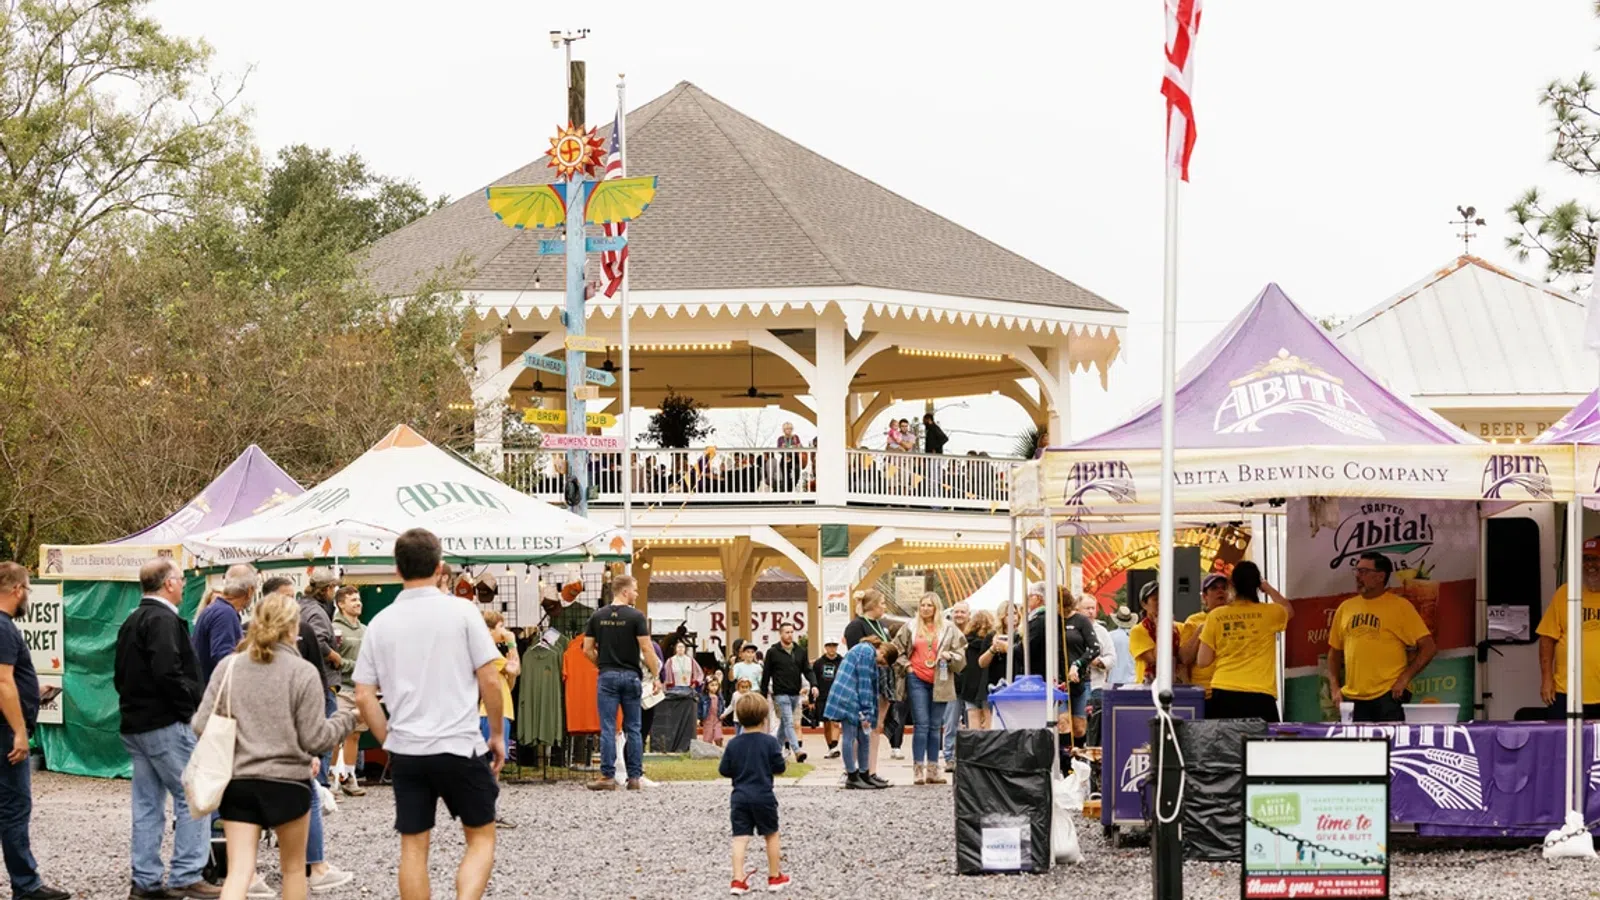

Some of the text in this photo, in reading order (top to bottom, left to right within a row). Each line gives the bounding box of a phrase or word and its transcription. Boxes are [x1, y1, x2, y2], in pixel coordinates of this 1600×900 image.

[528, 355, 562, 372] TRAILHEAD
[586, 370, 607, 382] SEUM
[1213, 374, 1367, 431] ABITA
[536, 411, 560, 421] BREW
[586, 415, 607, 425] PUB
[1480, 422, 1527, 436] BEER
[590, 438, 618, 448] CENTER
[1064, 460, 1133, 499] ABITA
[1238, 463, 1336, 483] BREWING
[1343, 460, 1449, 483] COMPANY
[1481, 454, 1549, 494] ABITA
[397, 480, 512, 518] ABITA
[1361, 503, 1405, 516] CRAFTED
[473, 536, 517, 550] FALL
[522, 536, 564, 550] FEST
[1330, 513, 1427, 569] Abita!
[1316, 814, 1372, 831] time to
[1247, 878, 1314, 898] thank you
